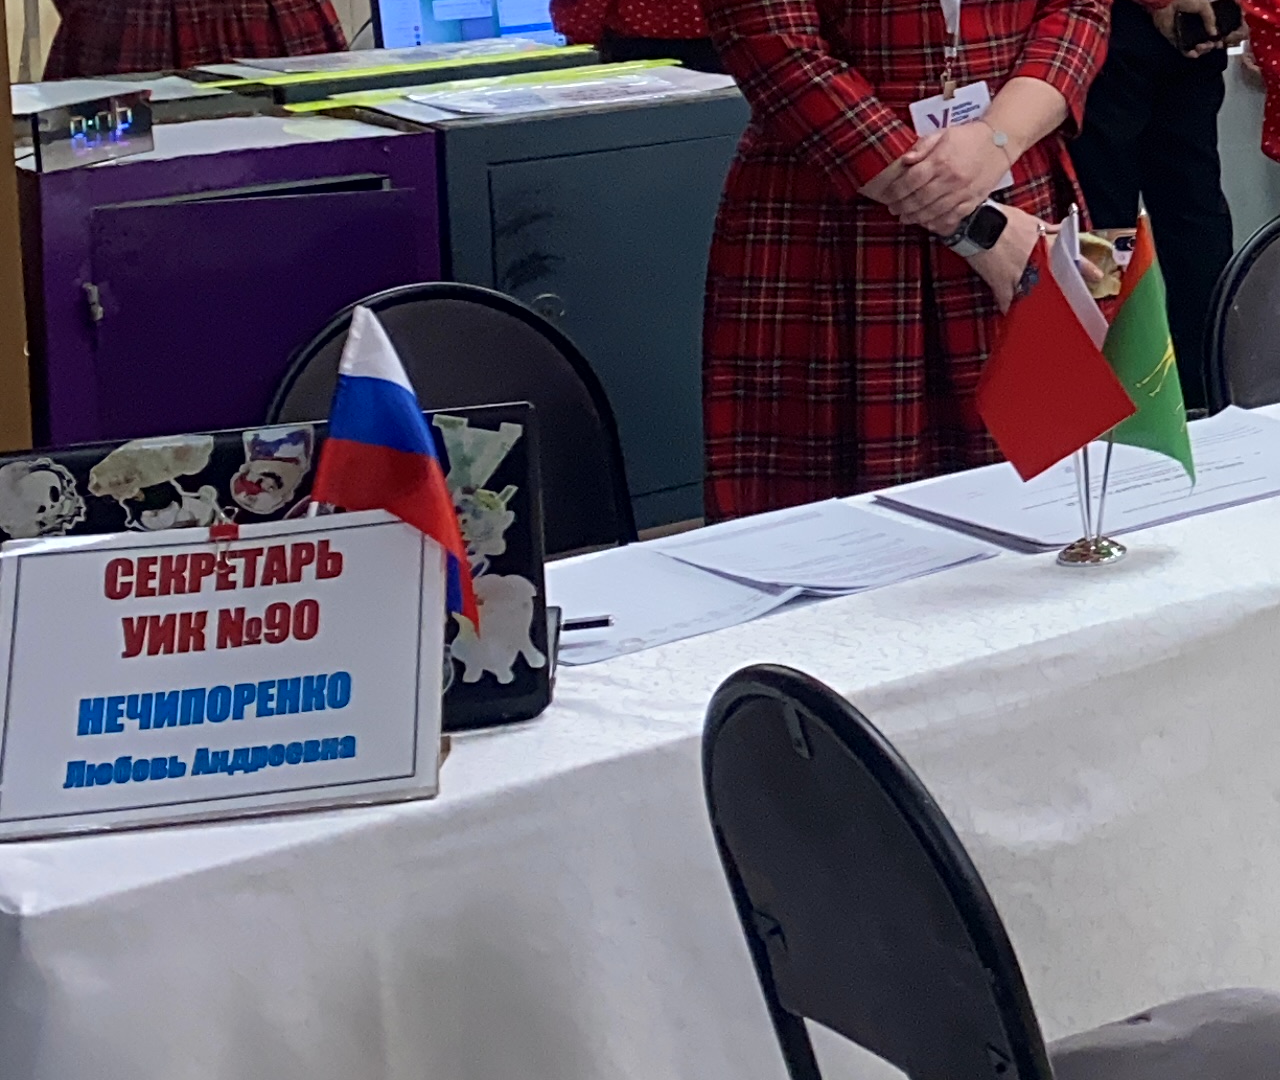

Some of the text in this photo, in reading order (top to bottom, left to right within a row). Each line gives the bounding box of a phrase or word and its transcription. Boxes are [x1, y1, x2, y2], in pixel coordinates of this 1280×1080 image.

[103, 539, 344, 600] СЕКРЕТАРЬ
[121, 599, 320, 659] УИК №90
[77, 671, 352, 736] НЕЧИПОРЕНКО
[63, 734, 356, 789] Любовь Андреевна
